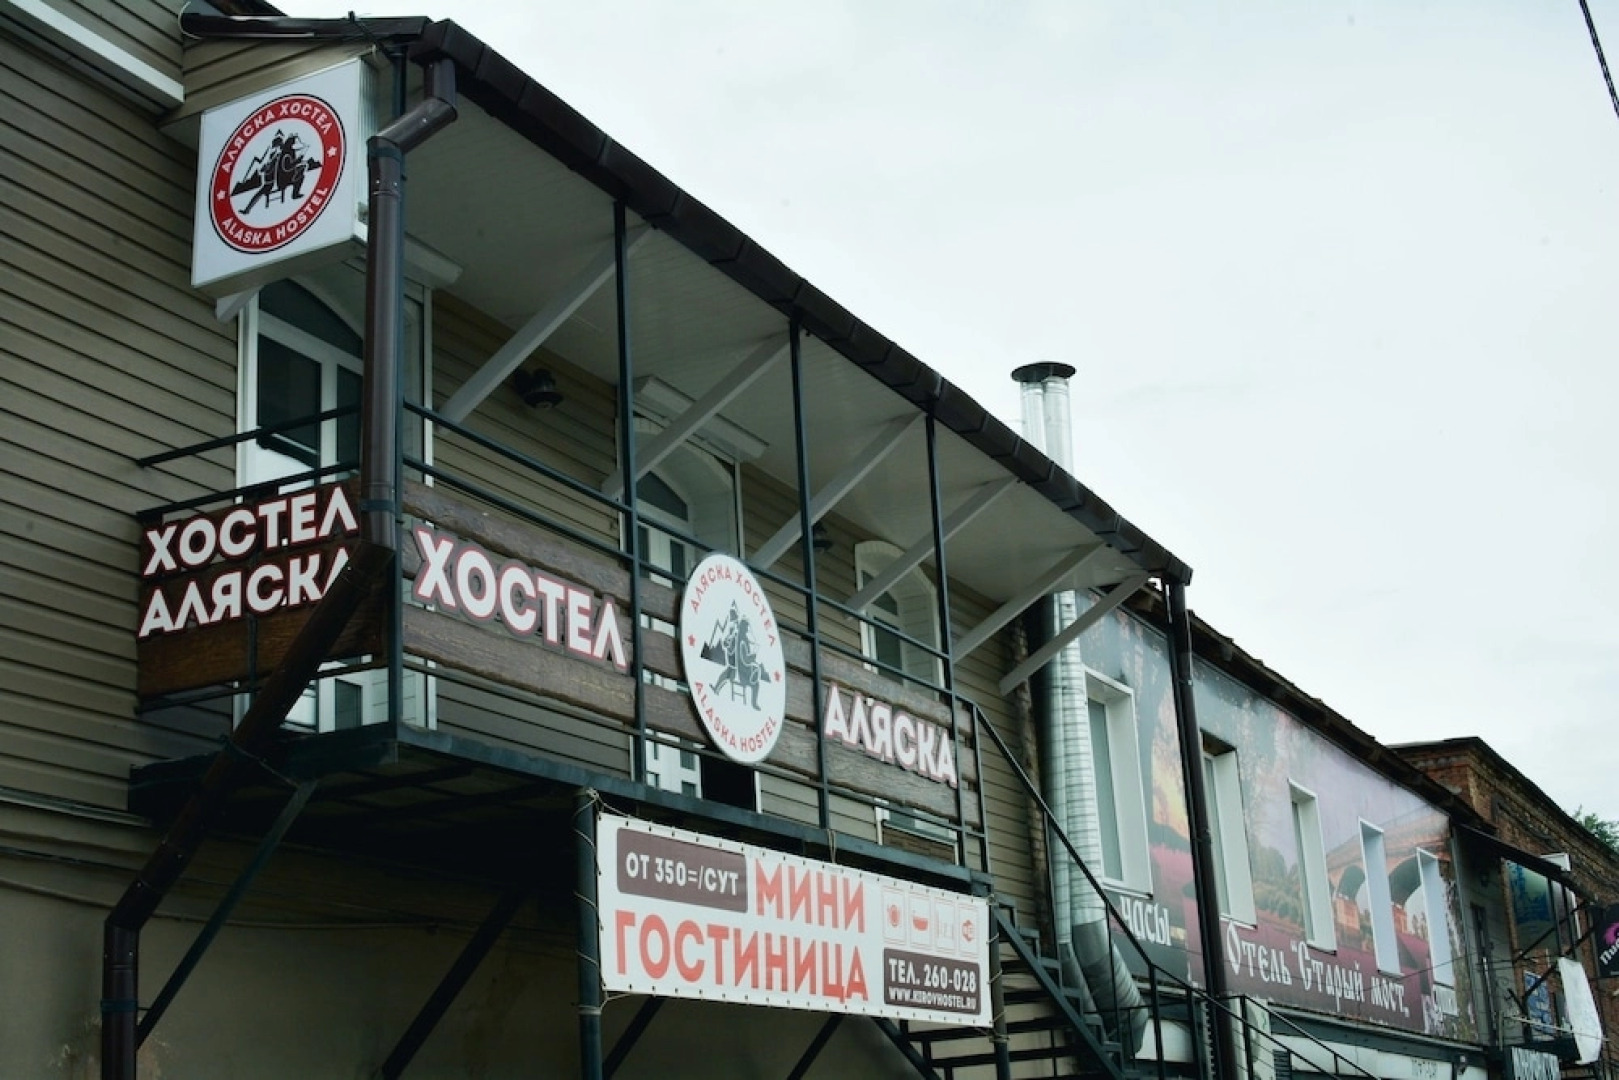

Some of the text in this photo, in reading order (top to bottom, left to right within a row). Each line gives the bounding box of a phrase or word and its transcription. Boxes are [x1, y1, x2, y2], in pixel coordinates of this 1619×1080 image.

[221, 102, 333, 173] АЛЯСКА ХОСТЕЛ
[221, 186, 330, 246] ALASKA HOSTEL
[144, 486, 358, 575] ХОСТЕЛ
[690, 564, 776, 647] АЛЯСКА ХОСТЕЛ
[417, 530, 958, 787] ХОСТЕЛ АЛЯСКА
[695, 680, 777, 752] ALASKA HOSTEL
[626, 852, 739, 896] ОТ 350=/СУТ
[755, 858, 865, 933] МИНИ
[615, 909, 869, 1004] ГОСТИНИЦА
[888, 957, 977, 993] ТЕЛ. 260-028
[1226, 919, 1292, 986] Отель
